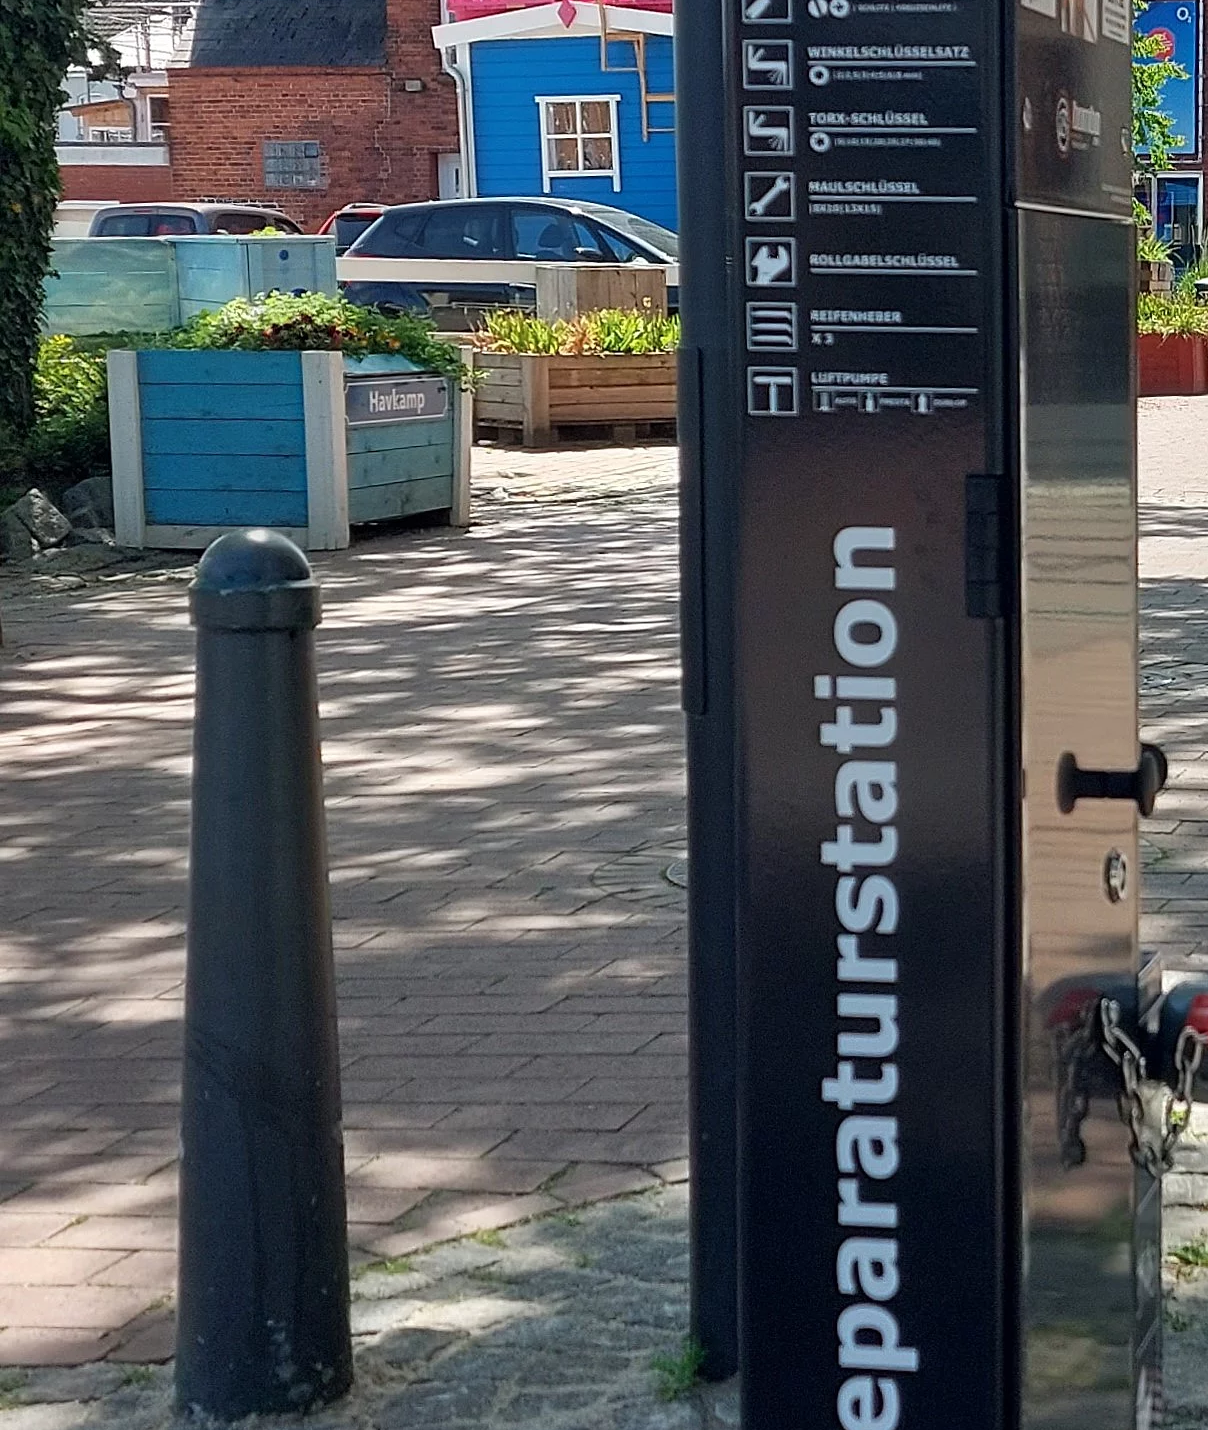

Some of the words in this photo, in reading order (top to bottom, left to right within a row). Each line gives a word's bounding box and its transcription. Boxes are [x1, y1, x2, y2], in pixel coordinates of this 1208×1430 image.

[807, 44, 970, 58] WINKELSCHLÜSSELSATZ
[808, 110, 929, 125] TORX-SCHLÜSSEL
[808, 179, 920, 194] MAULSCHLÜSSEL
[809, 253, 959, 268] ROLLGABELSCHLÜSSEL
[810, 310, 903, 323] REIFENHEBER
[811, 372, 889, 386] LUFTPUMPE
[369, 389, 425, 414] Havkamp
